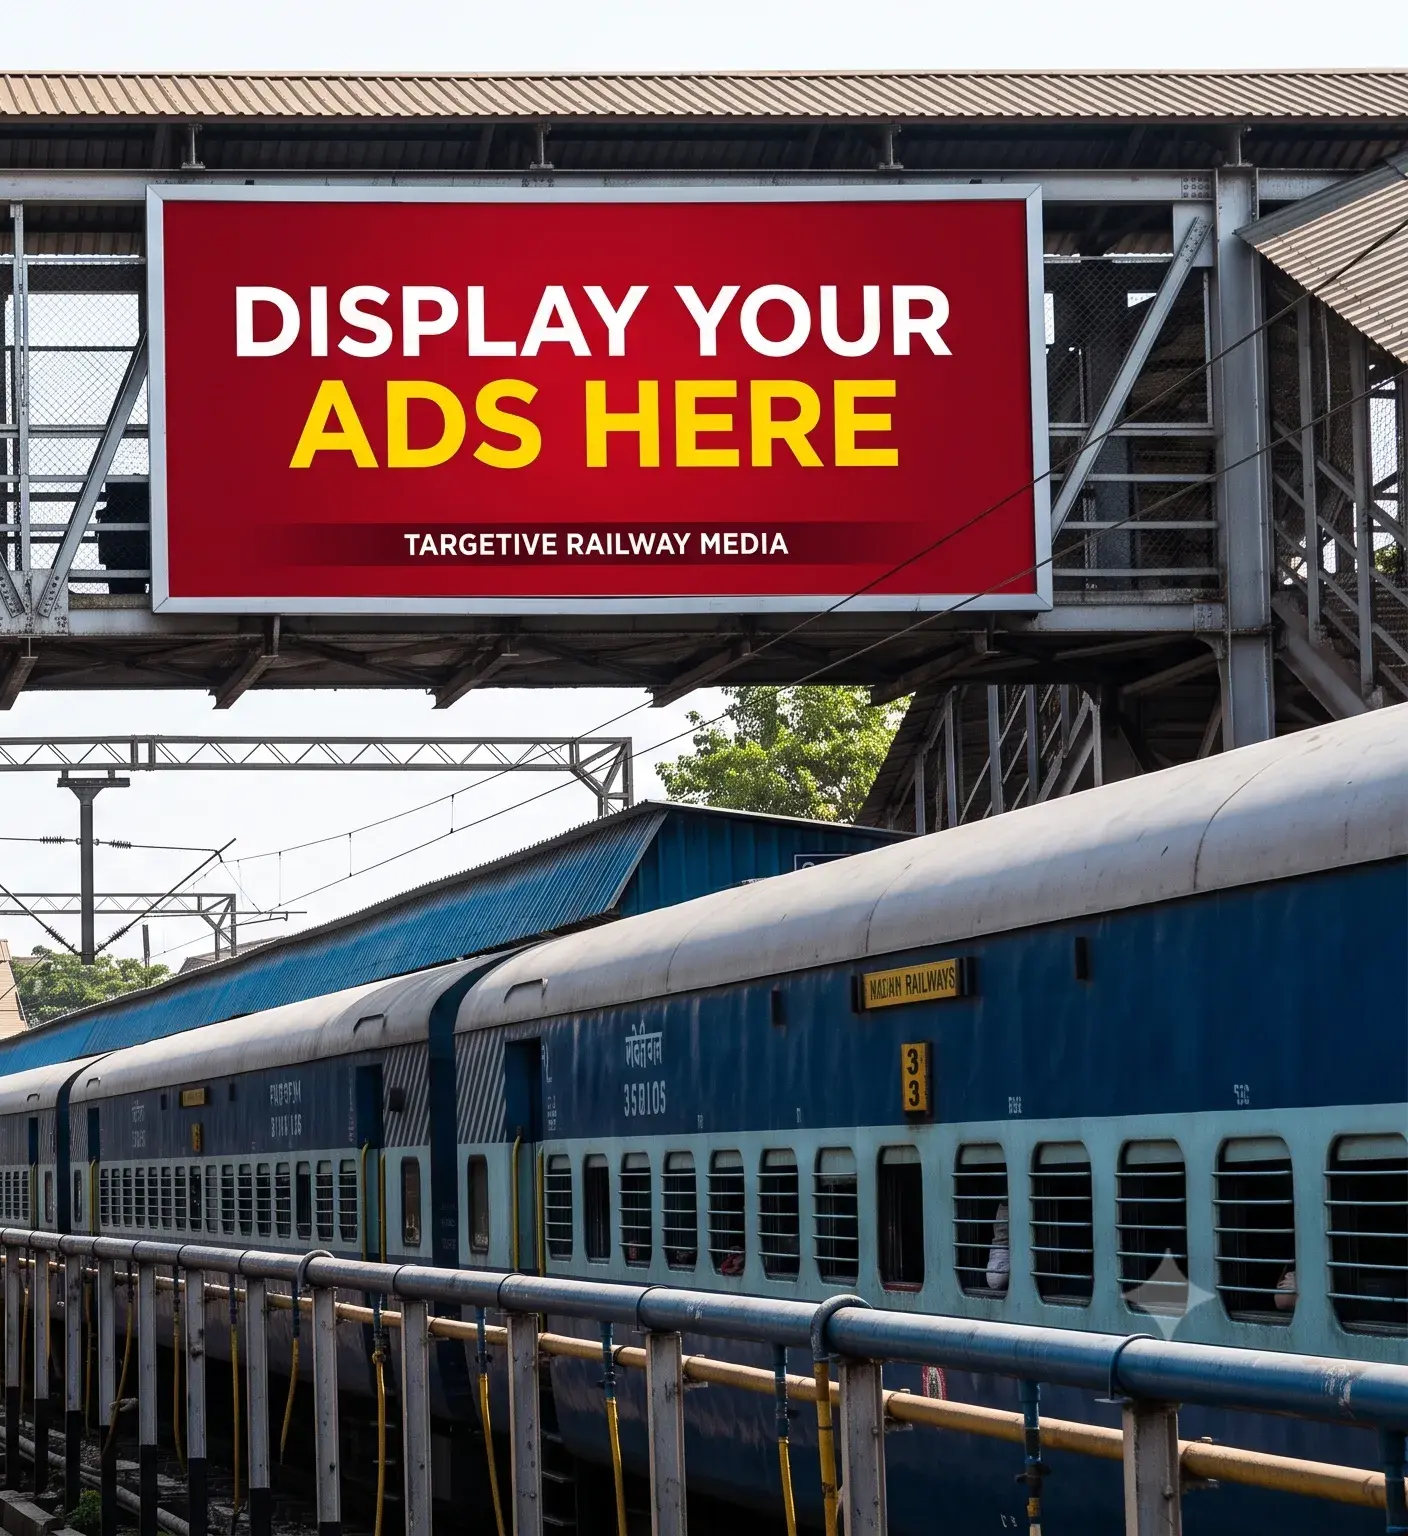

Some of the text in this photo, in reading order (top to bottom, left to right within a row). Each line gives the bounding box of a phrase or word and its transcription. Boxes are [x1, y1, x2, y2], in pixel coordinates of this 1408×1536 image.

[235, 283, 953, 358] DISPLAY YOUR
[288, 378, 899, 469] ADS HERE
[403, 532, 789, 556] TARGETIVE RAILWAY MEDIA
[905, 966, 956, 996] RAILWAYS
[907, 1048, 919, 1076] 3
[908, 1080, 921, 1107] 3
